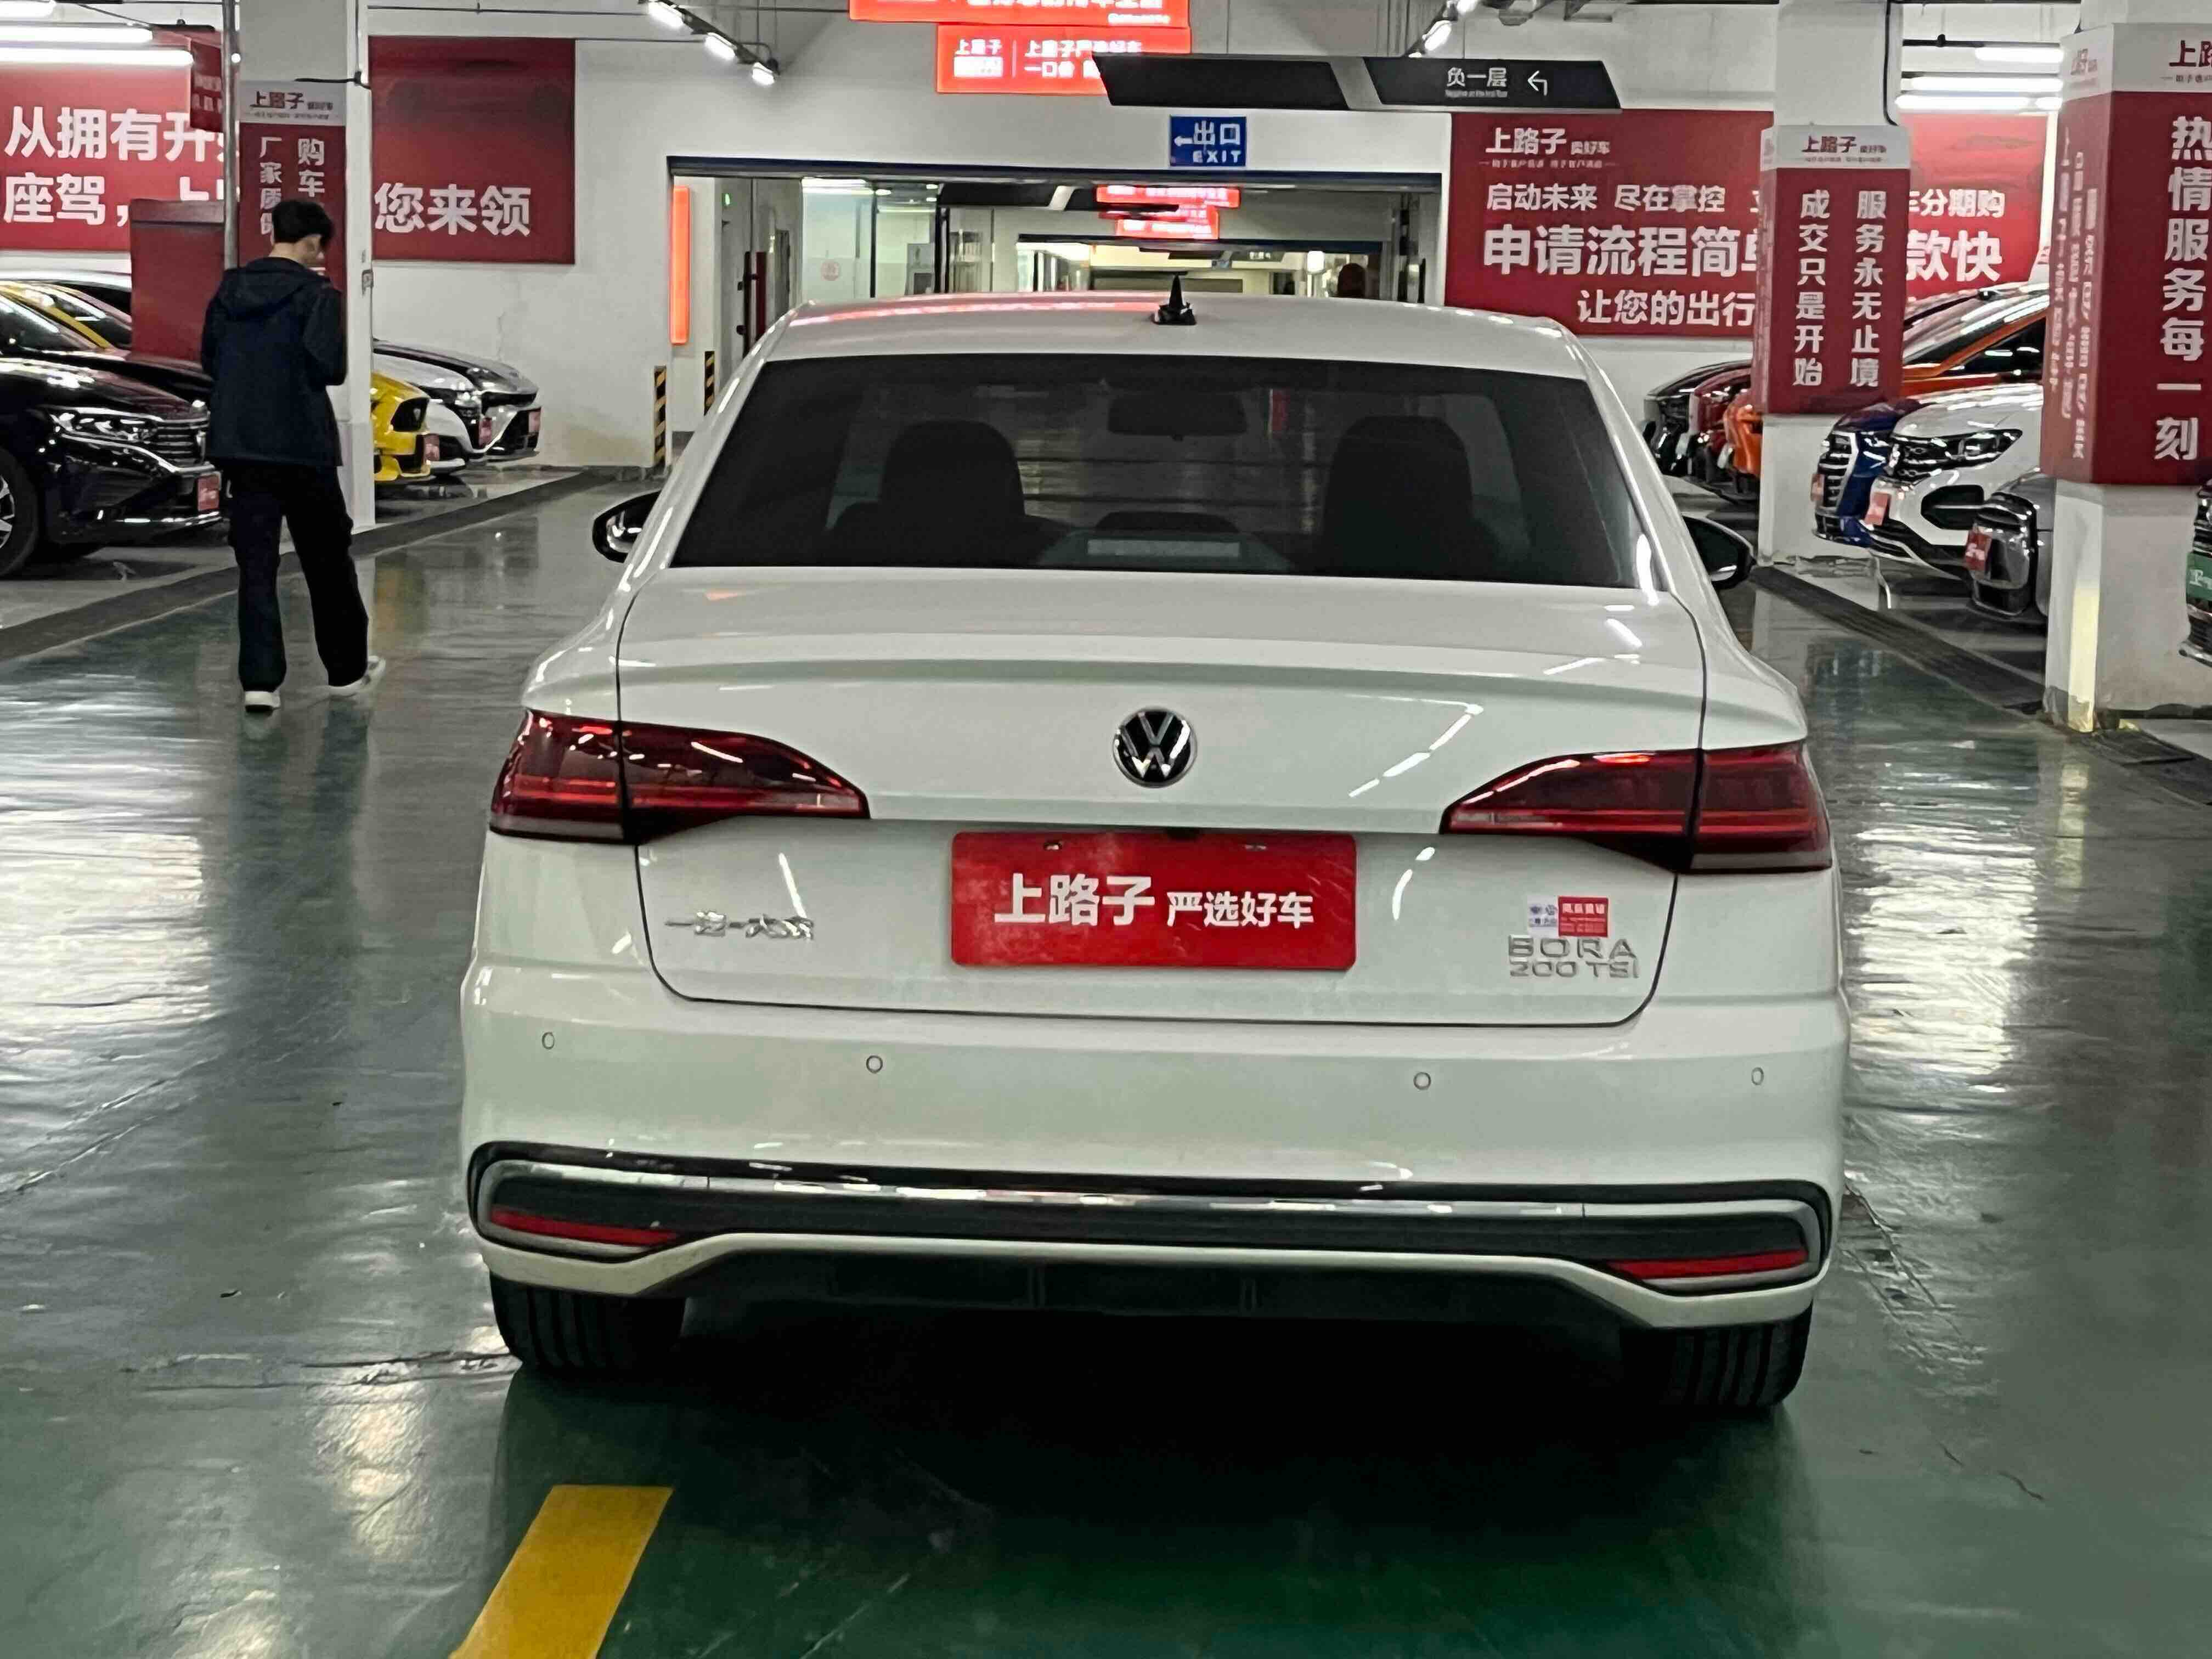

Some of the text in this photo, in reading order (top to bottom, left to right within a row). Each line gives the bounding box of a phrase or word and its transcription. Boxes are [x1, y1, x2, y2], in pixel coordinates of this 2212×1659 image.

[1446, 67, 1507, 87] 负一层
[4, 105, 224, 162] 从拥有开
[1193, 120, 1240, 146] 出口
[1485, 127, 1567, 155] 上路子
[1193, 150, 1242, 163] EXIT
[374, 182, 532, 237] 您来领
[1486, 183, 1598, 211] 启动未来
[1614, 184, 1726, 213] 尽在掌控
[1792, 189, 1830, 386] 成交只是开始
[1849, 190, 1887, 387] 服务永无止境
[2154, 115, 2212, 461] 热情服务每一刻
[1576, 289, 1756, 327] 让您的出行
[994, 873, 1314, 929] 上路子 严选好车
[1509, 935, 1638, 959] BORA
